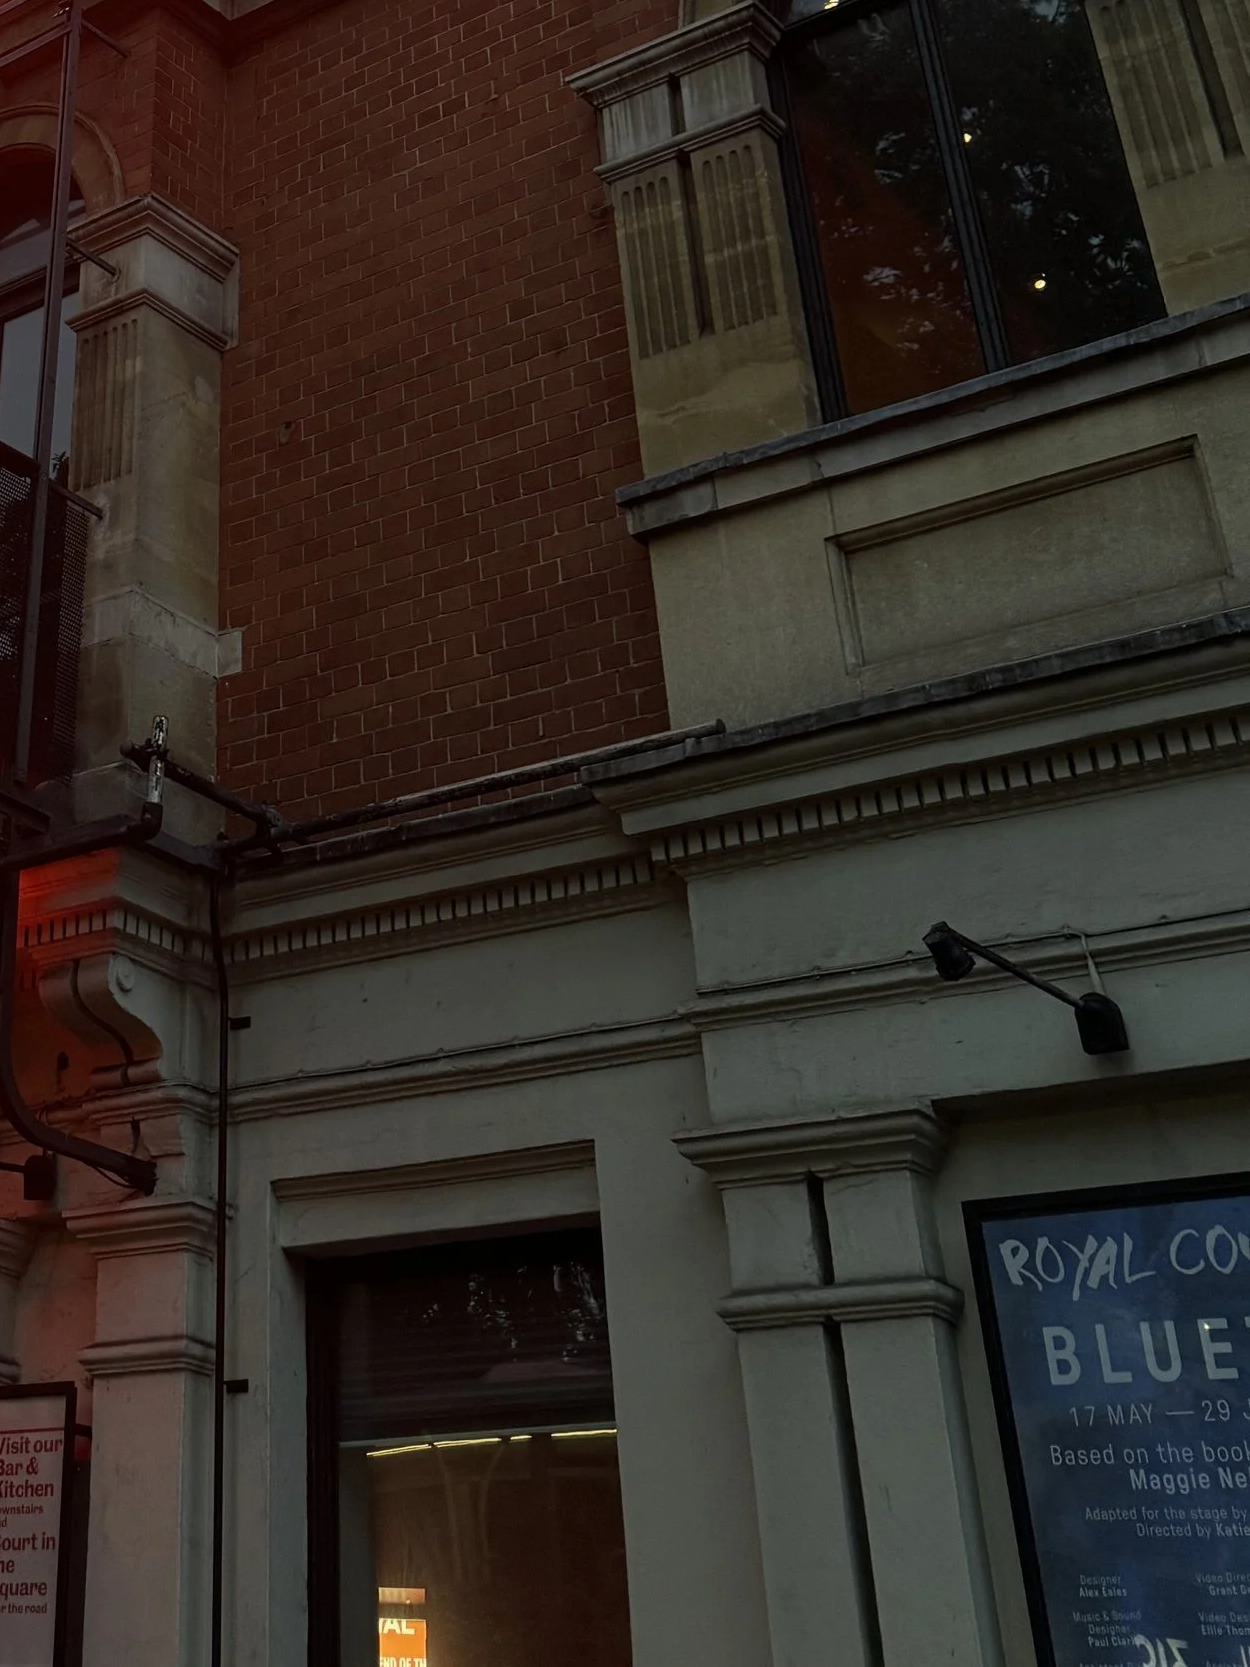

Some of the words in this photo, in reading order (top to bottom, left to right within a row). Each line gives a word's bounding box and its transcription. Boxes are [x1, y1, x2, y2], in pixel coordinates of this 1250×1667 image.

[998, 1231, 1157, 1302] ROYAL
[1041, 1315, 1250, 1386] BLUE
[1069, 1404, 1096, 1427] 17
[1106, 1402, 1153, 1426] MAY
[1201, 1398, 1231, 1422] 29
[33, 1439, 63, 1454] our
[1049, 1442, 1115, 1466] Based
[1122, 1446, 1150, 1465] on
[1155, 1441, 1195, 1464] the
[26, 1456, 39, 1475] &
[1128, 1465, 1212, 1495] Maggie
[1084, 1506, 1138, 1523] Adapted
[1141, 1506, 1159, 1520] for
[1164, 1505, 1187, 1520] the
[1190, 1505, 1228, 1523] stage
[1231, 1505, 1247, 1522] by
[1136, 1522, 1192, 1538] Directed
[1196, 1521, 1211, 1540] by
[41, 1531, 56, 1550] in
[1079, 1574, 1121, 1588] Designer
[8, 1602, 24, 1614] the
[24, 1602, 48, 1614] road
